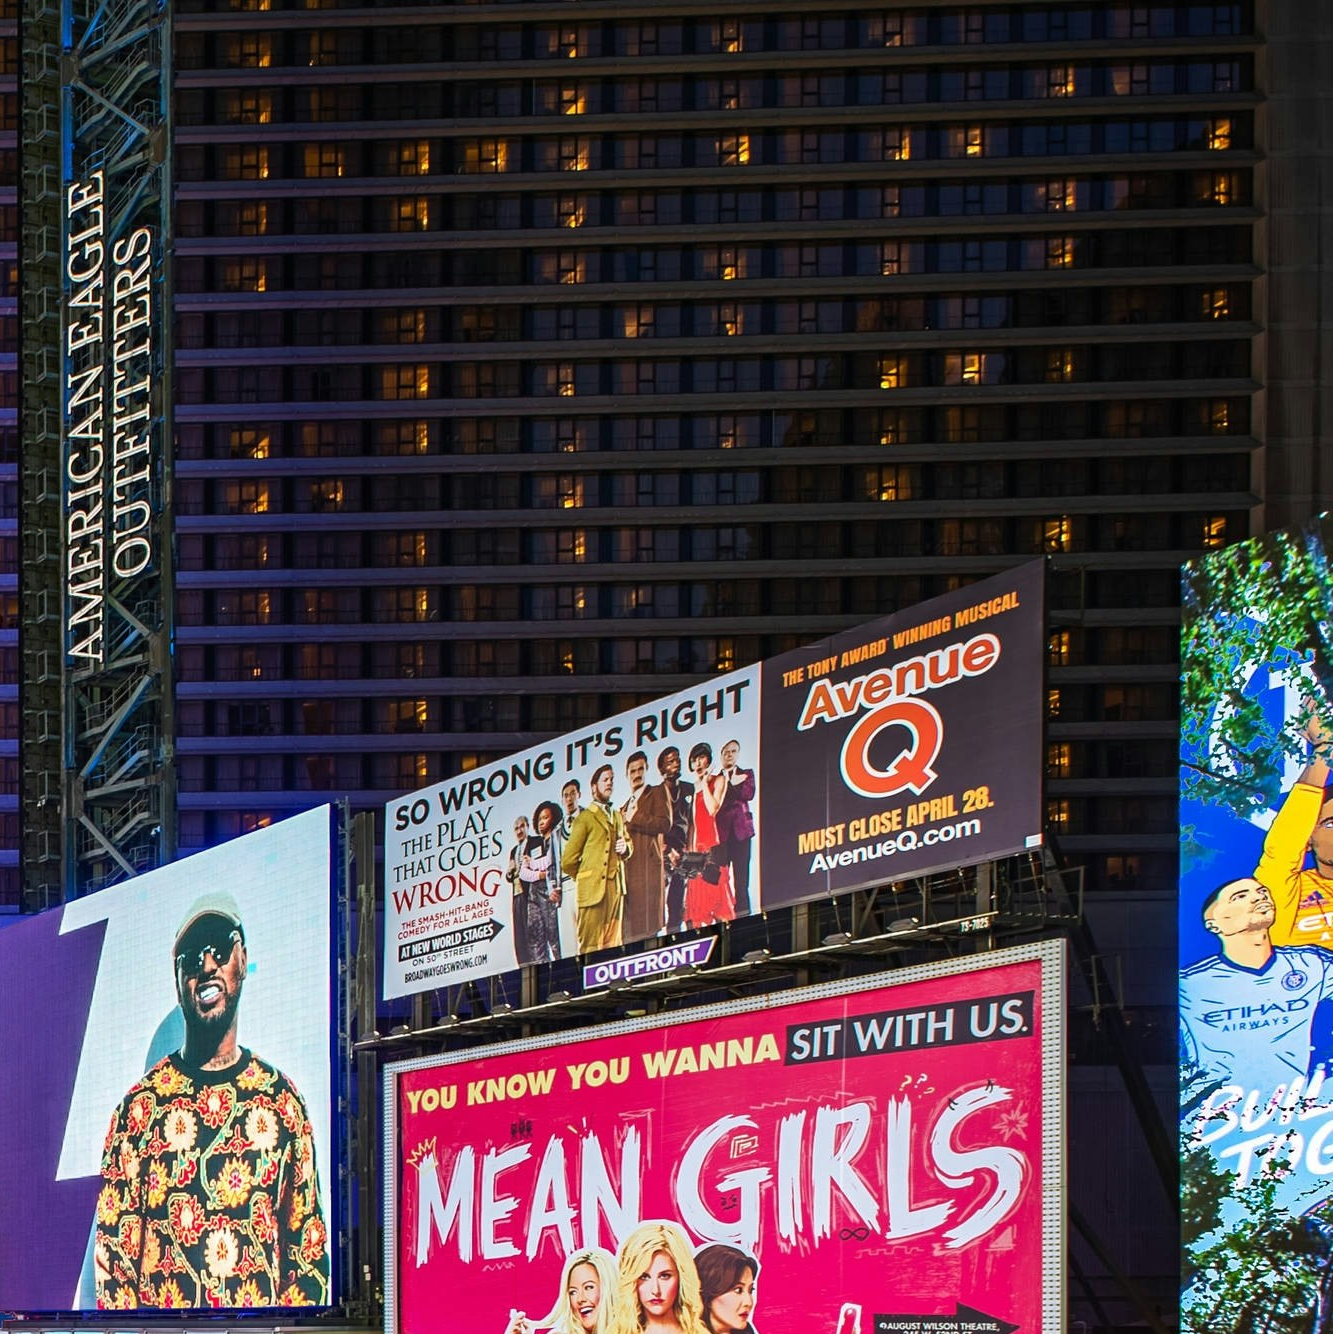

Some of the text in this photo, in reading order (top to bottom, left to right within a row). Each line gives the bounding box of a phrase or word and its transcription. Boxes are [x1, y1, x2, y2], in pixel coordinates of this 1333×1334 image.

[67, 168, 104, 663] AMERICAN EAGLE
[113, 226, 151, 578] OUTFITTERS
[955, 591, 1020, 630] MUSICAL
[797, 632, 1002, 732] Avenue
[395, 679, 752, 831] SO WRONG IT'S RIGHT
[839, 696, 944, 799] Q
[437, 805, 494, 848] PLAY
[438, 830, 503, 872] GOES
[798, 796, 958, 856] MUST CLOSE APRIL
[809, 815, 982, 877] AvenueQ.com
[391, 866, 502, 915] WRONG
[432, 923, 494, 951] WORLD STAGES
[1221, 1015, 1290, 1033] AIRWAYS
[406, 999, 1028, 1115] YOU KNOW YOU WANNA SIT WITH US.
[414, 1119, 641, 1268] MEAN
[676, 1082, 1026, 1252] GIRLS
[887, 1322, 959, 1331] AUGUST WILSON
